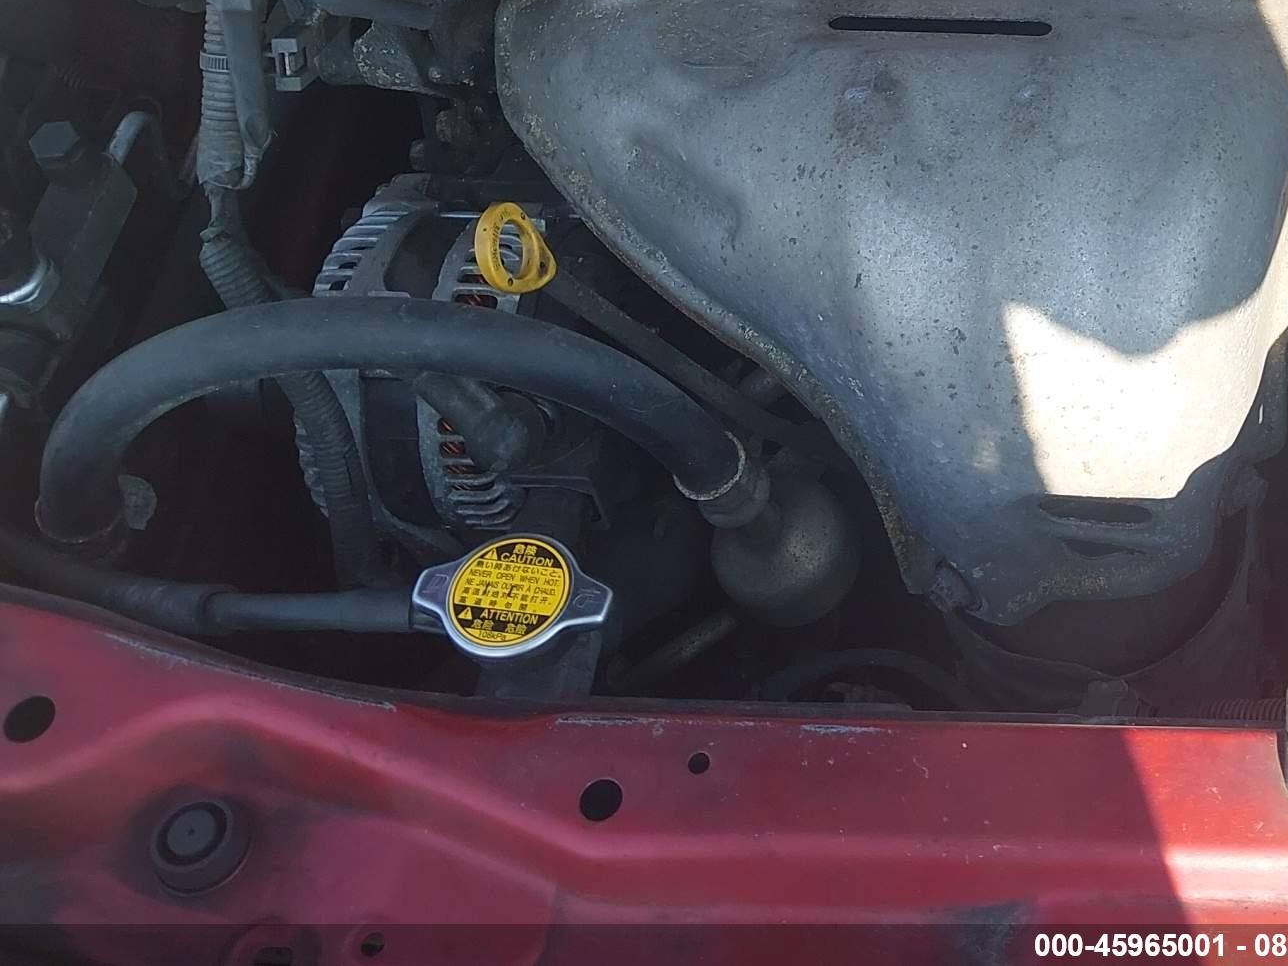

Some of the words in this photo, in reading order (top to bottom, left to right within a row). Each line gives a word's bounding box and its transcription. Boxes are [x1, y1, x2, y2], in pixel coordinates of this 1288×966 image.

[500, 552, 553, 567] CAUTION
[470, 569, 492, 578] NEVER
[496, 572, 516, 581] OPEN
[520, 575, 540, 584] WHEN
[480, 608, 539, 625] ATTENTION
